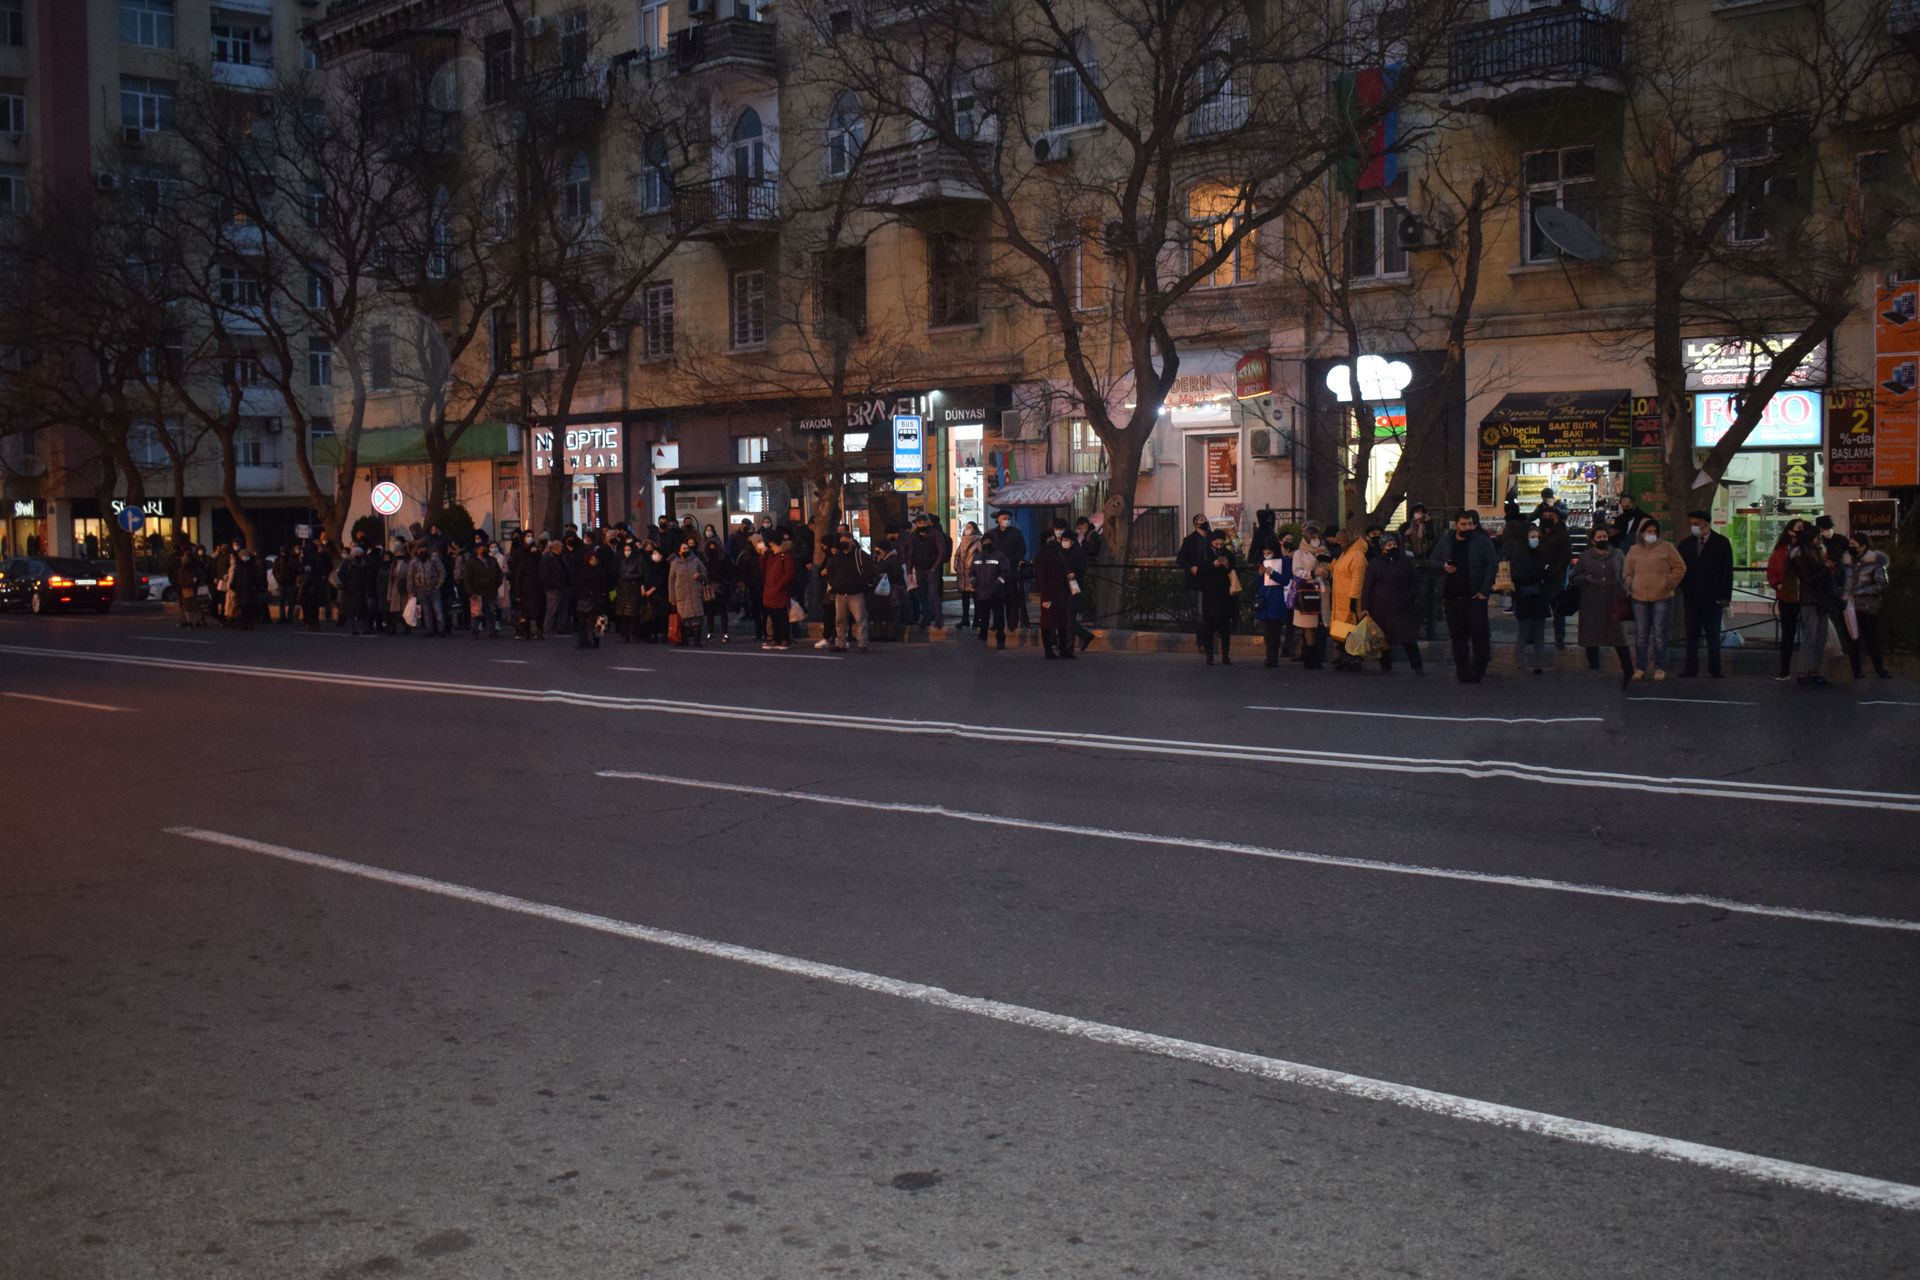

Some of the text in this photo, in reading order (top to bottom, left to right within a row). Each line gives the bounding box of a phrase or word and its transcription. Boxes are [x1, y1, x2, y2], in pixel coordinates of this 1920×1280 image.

[1548, 421, 1571, 430] SAAT
[1851, 409, 1870, 433] 2
[566, 428, 617, 450] OPTIC
